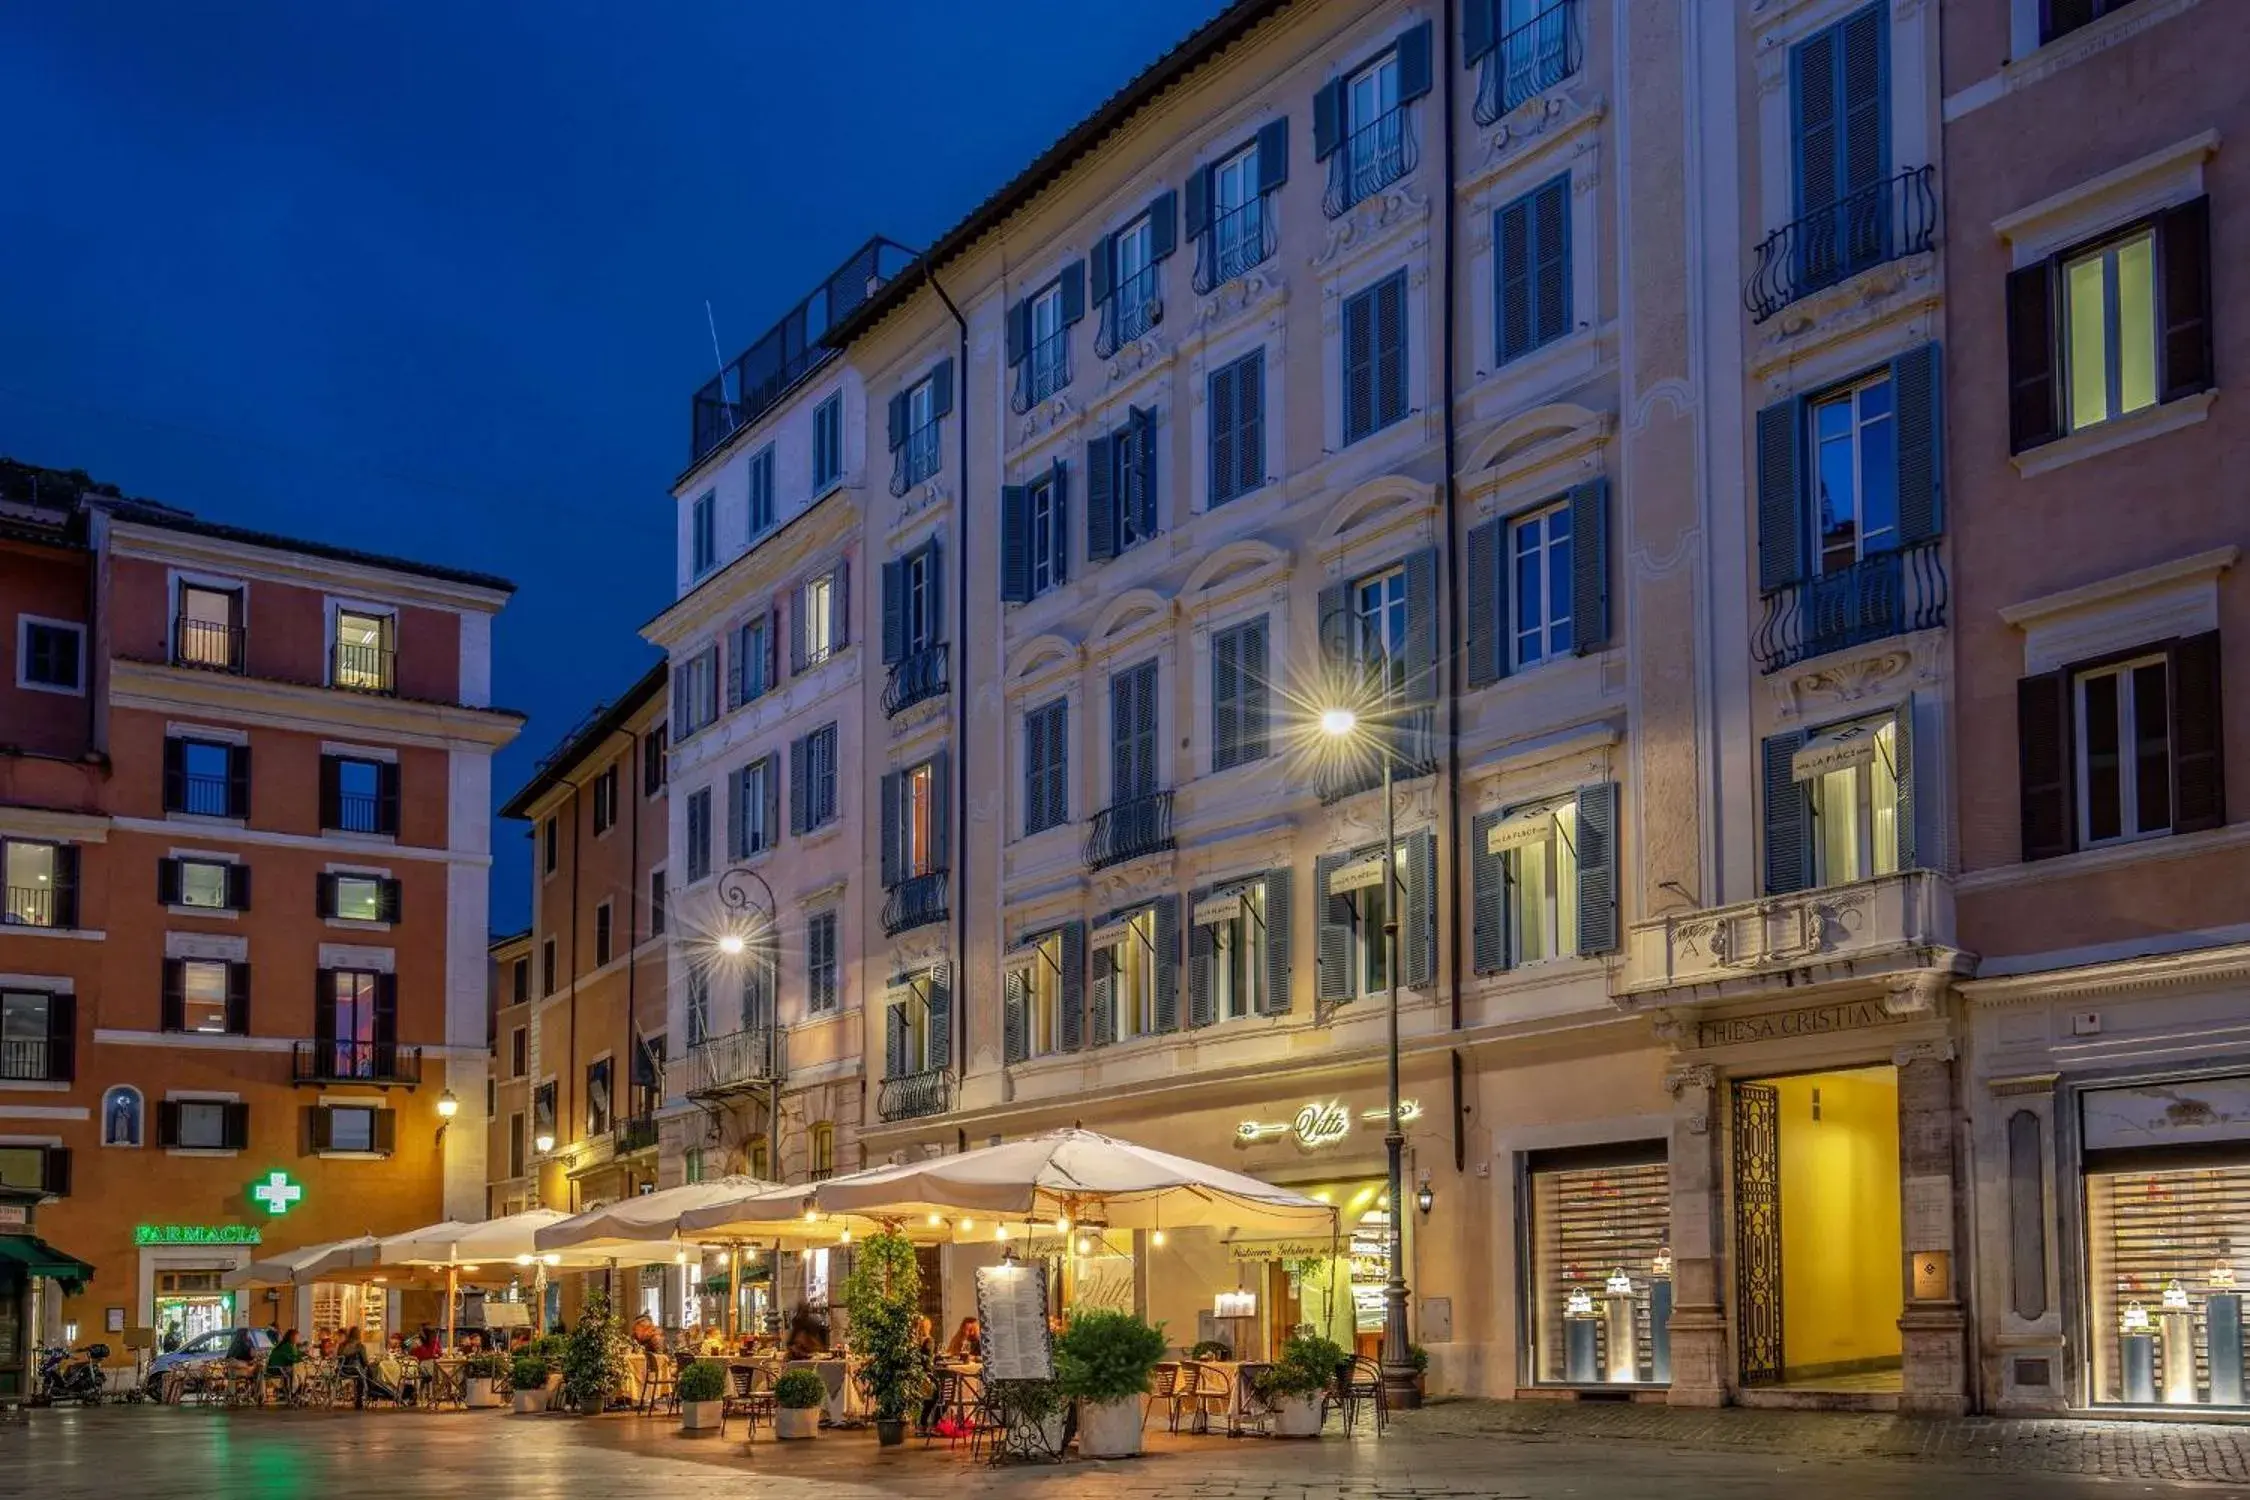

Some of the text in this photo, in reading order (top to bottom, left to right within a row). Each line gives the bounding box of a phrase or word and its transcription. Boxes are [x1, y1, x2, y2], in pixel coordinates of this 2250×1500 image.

[1781, 1002, 1907, 1034] CRISTIAN
[1294, 1099, 1346, 1143] Vitti
[135, 1225, 262, 1242] FARMACIA
